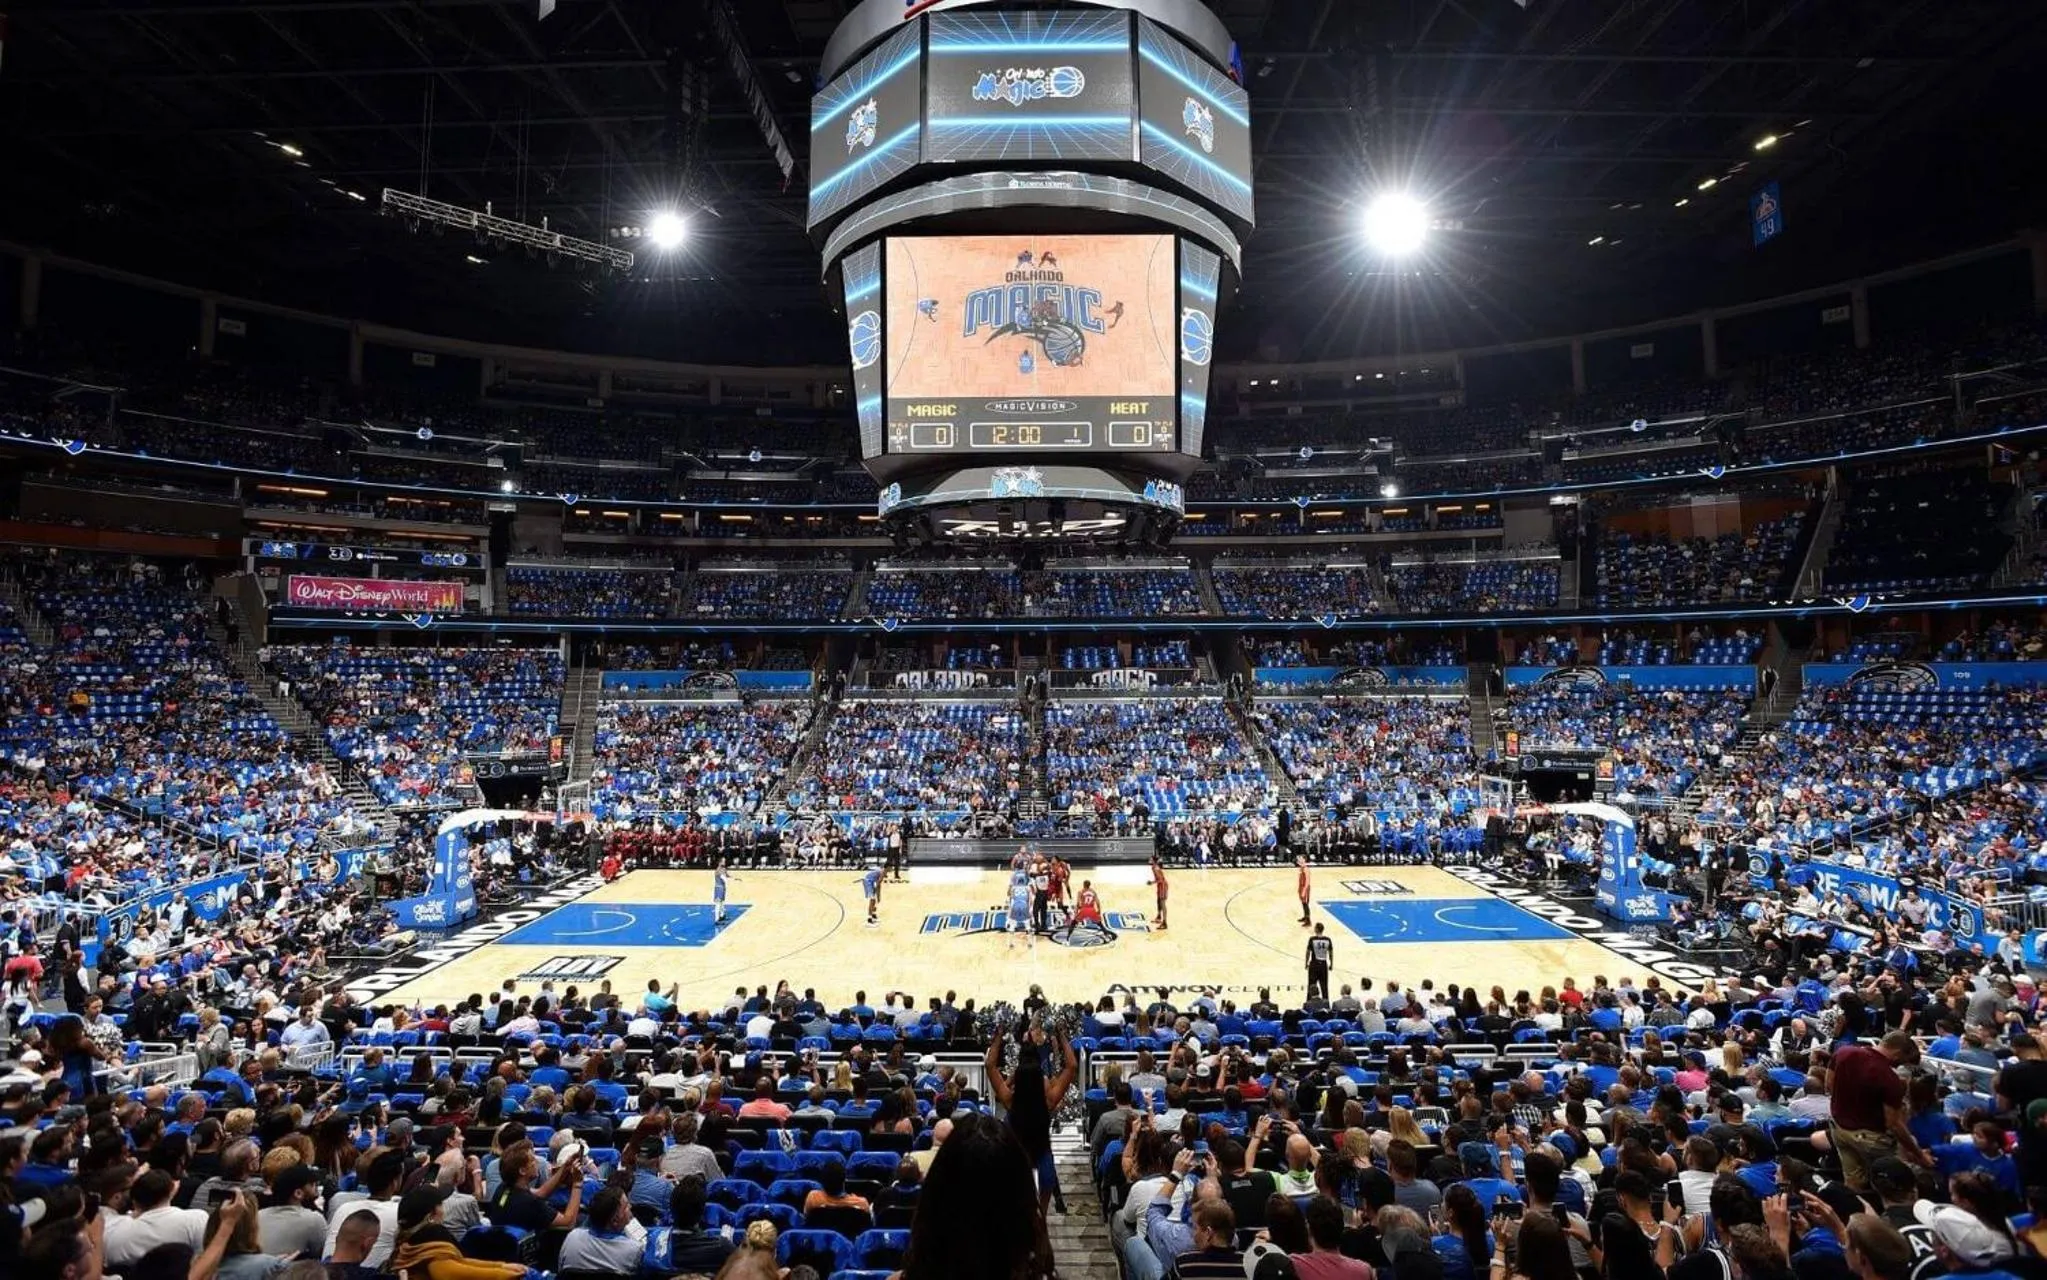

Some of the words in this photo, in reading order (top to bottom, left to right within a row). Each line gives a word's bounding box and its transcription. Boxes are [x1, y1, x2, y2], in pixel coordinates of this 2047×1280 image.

[1005, 270, 1064, 283] ORLANDO
[964, 283, 1105, 337] MAGIC
[907, 404, 957, 417] MAGIC
[1110, 402, 1150, 415] HEAT
[935, 427, 947, 444] 0
[992, 426, 1041, 444] 12:00
[1133, 426, 1145, 443] 0
[391, 590, 428, 601] World
